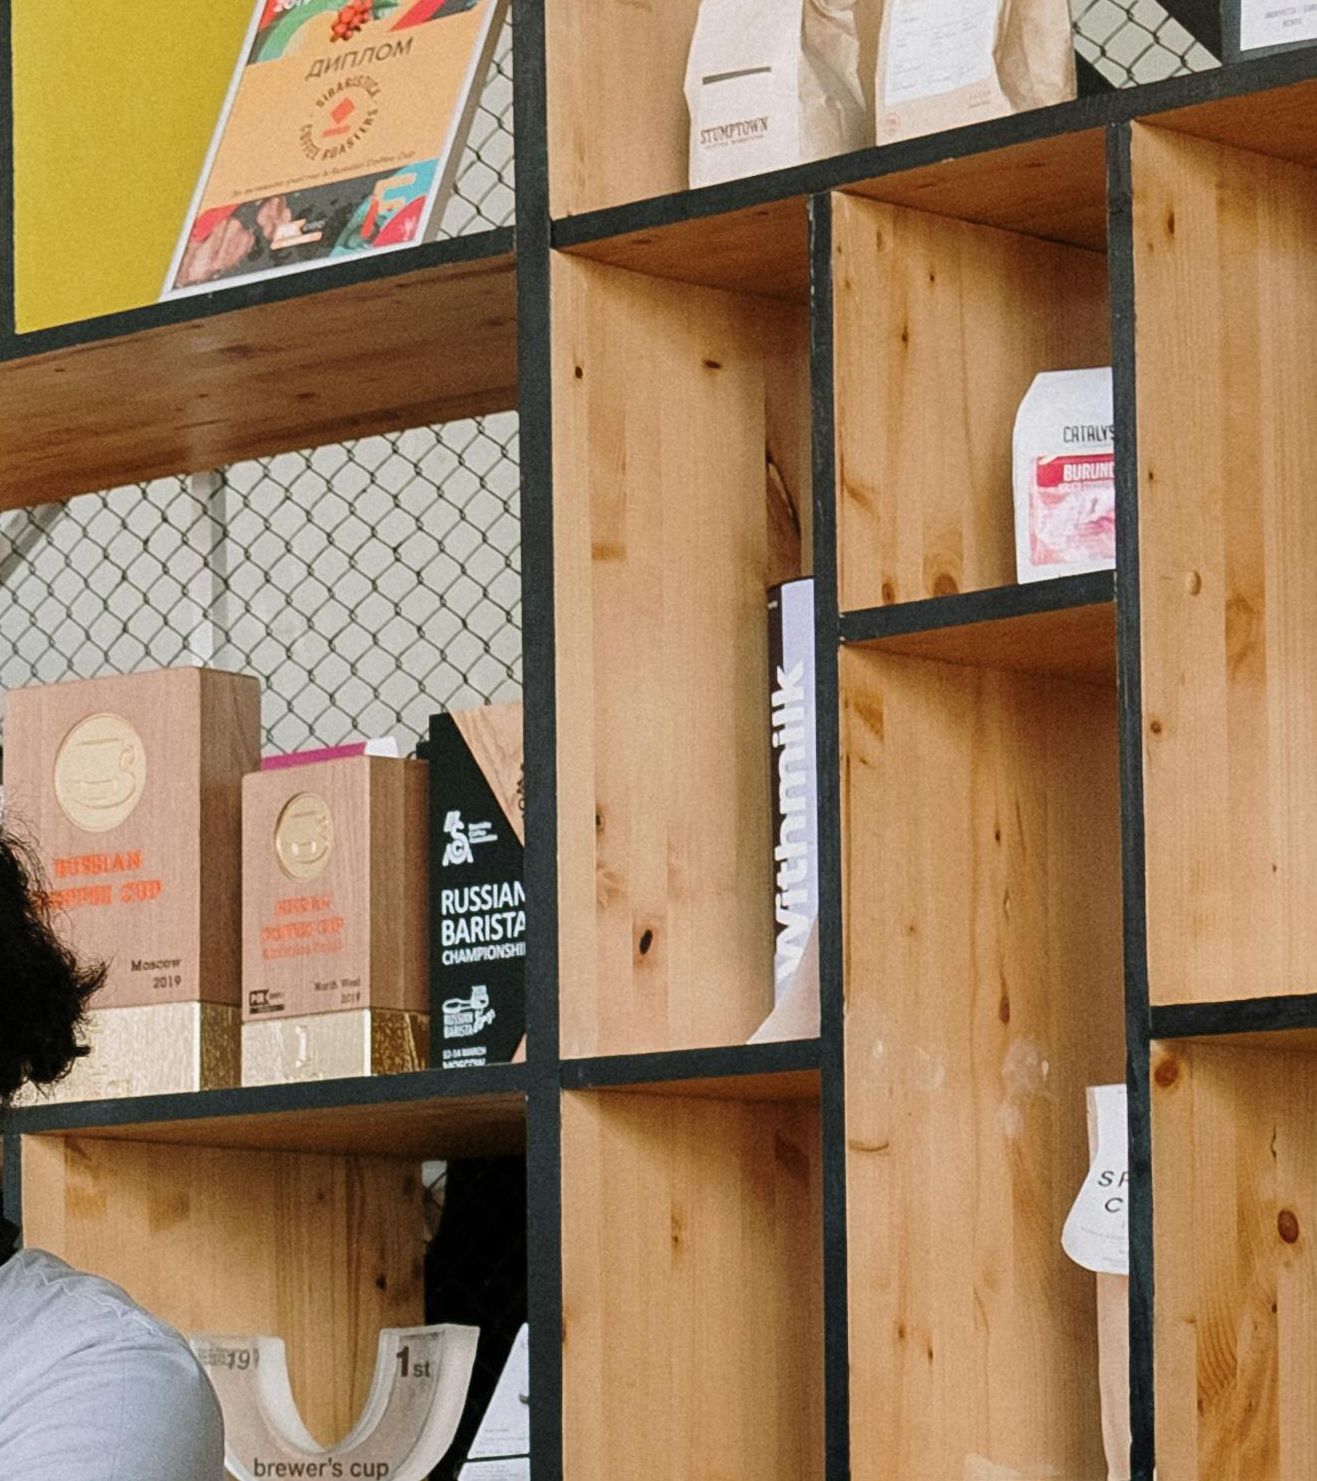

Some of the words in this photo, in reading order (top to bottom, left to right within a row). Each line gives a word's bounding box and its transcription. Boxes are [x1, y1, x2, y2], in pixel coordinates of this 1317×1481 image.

[304, 36, 414, 82] ДИПЛОМ
[699, 116, 770, 145] STUMPTOWN
[771, 660, 808, 987] withmilk
[53, 849, 143, 878] RUSSIAN
[120, 879, 163, 903] CUP
[441, 880, 526, 916] RUSSIAN
[441, 910, 526, 947] BARISTA
[129, 957, 182, 972] Moscow
[151, 974, 183, 989] 2019
[253, 1457, 343, 1478] brewer's
[350, 1460, 390, 1481] cup
